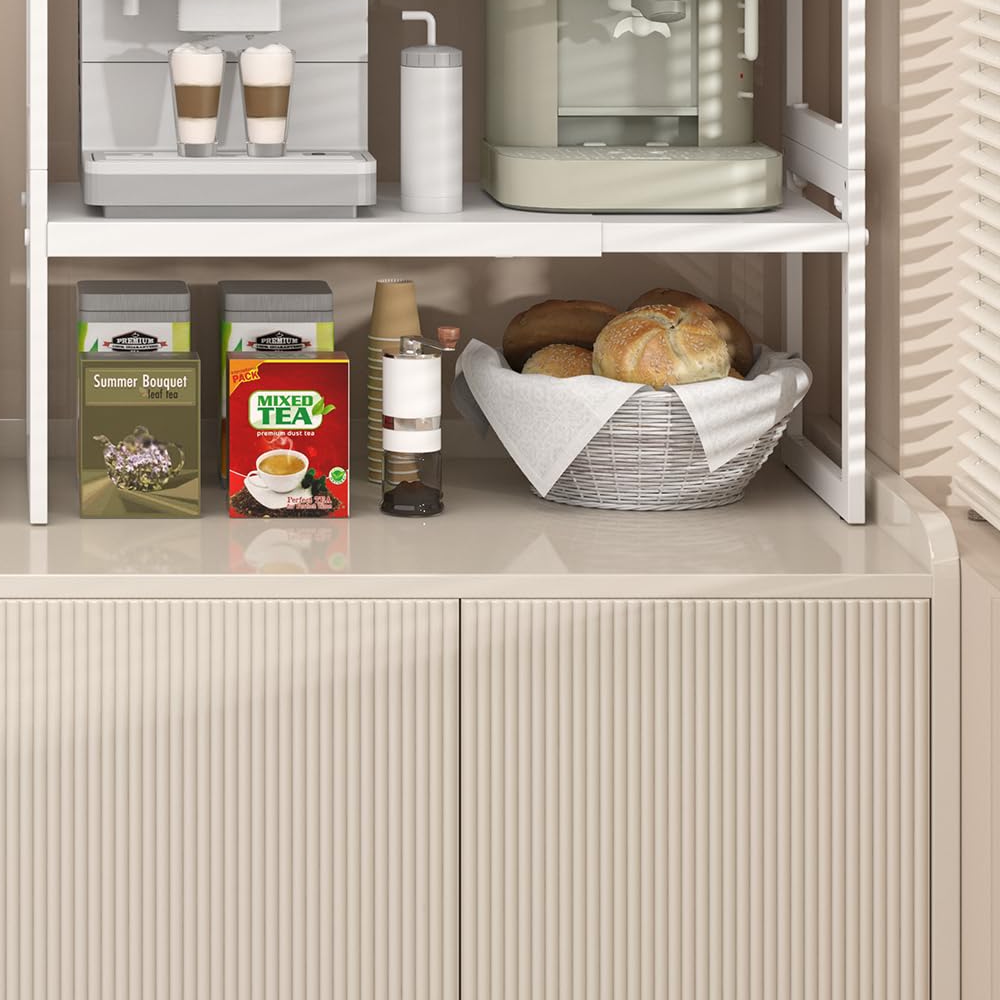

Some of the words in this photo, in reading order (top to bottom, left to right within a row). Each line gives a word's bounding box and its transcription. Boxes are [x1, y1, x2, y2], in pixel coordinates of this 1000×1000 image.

[93, 374, 138, 388] Summer
[142, 374, 187, 391] Bouquet
[232, 371, 259, 383] PACK
[147, 389, 163, 399] leaf
[165, 389, 178, 399] tea
[257, 395, 313, 407] MIXED
[257, 407, 313, 425] TEA
